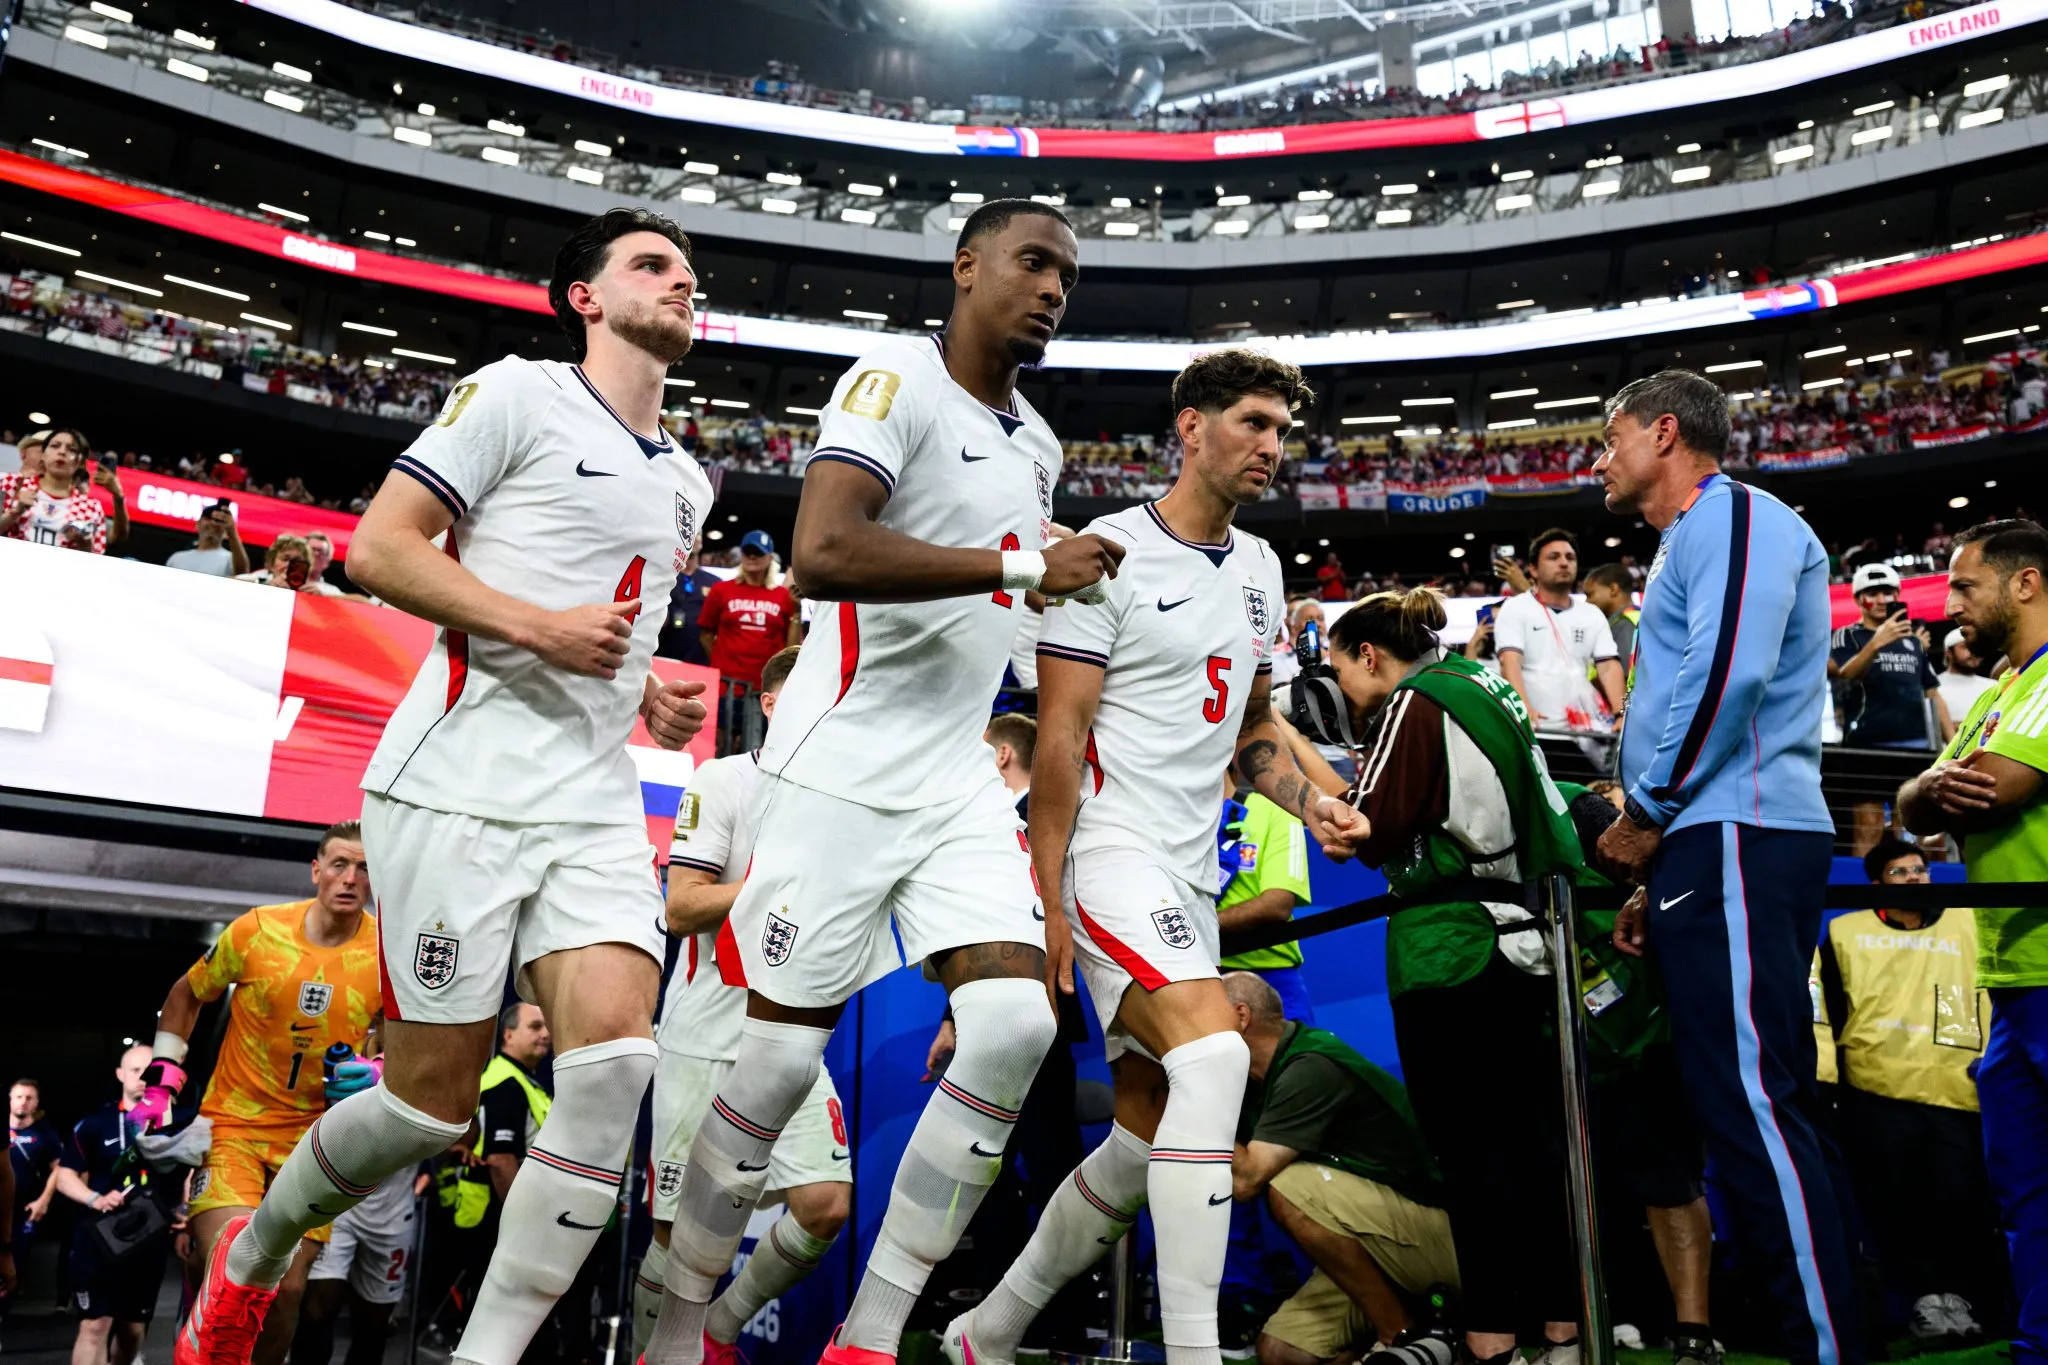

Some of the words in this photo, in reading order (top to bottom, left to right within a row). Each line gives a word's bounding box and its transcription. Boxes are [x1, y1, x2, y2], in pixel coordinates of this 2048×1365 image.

[1908, 8, 2000, 46] ENGLAND
[581, 76, 654, 107] ENGLAND
[138, 484, 239, 524] CROAT
[1402, 493, 1475, 513] GRUDE
[613, 554, 647, 626] 4
[728, 599, 780, 616] ENGLAND
[1202, 655, 1232, 724] 5
[1856, 934, 1961, 957] TECHNICAL
[287, 1051, 304, 1091] 1
[826, 1097, 848, 1147] 8
[742, 1298, 781, 1343] 26
